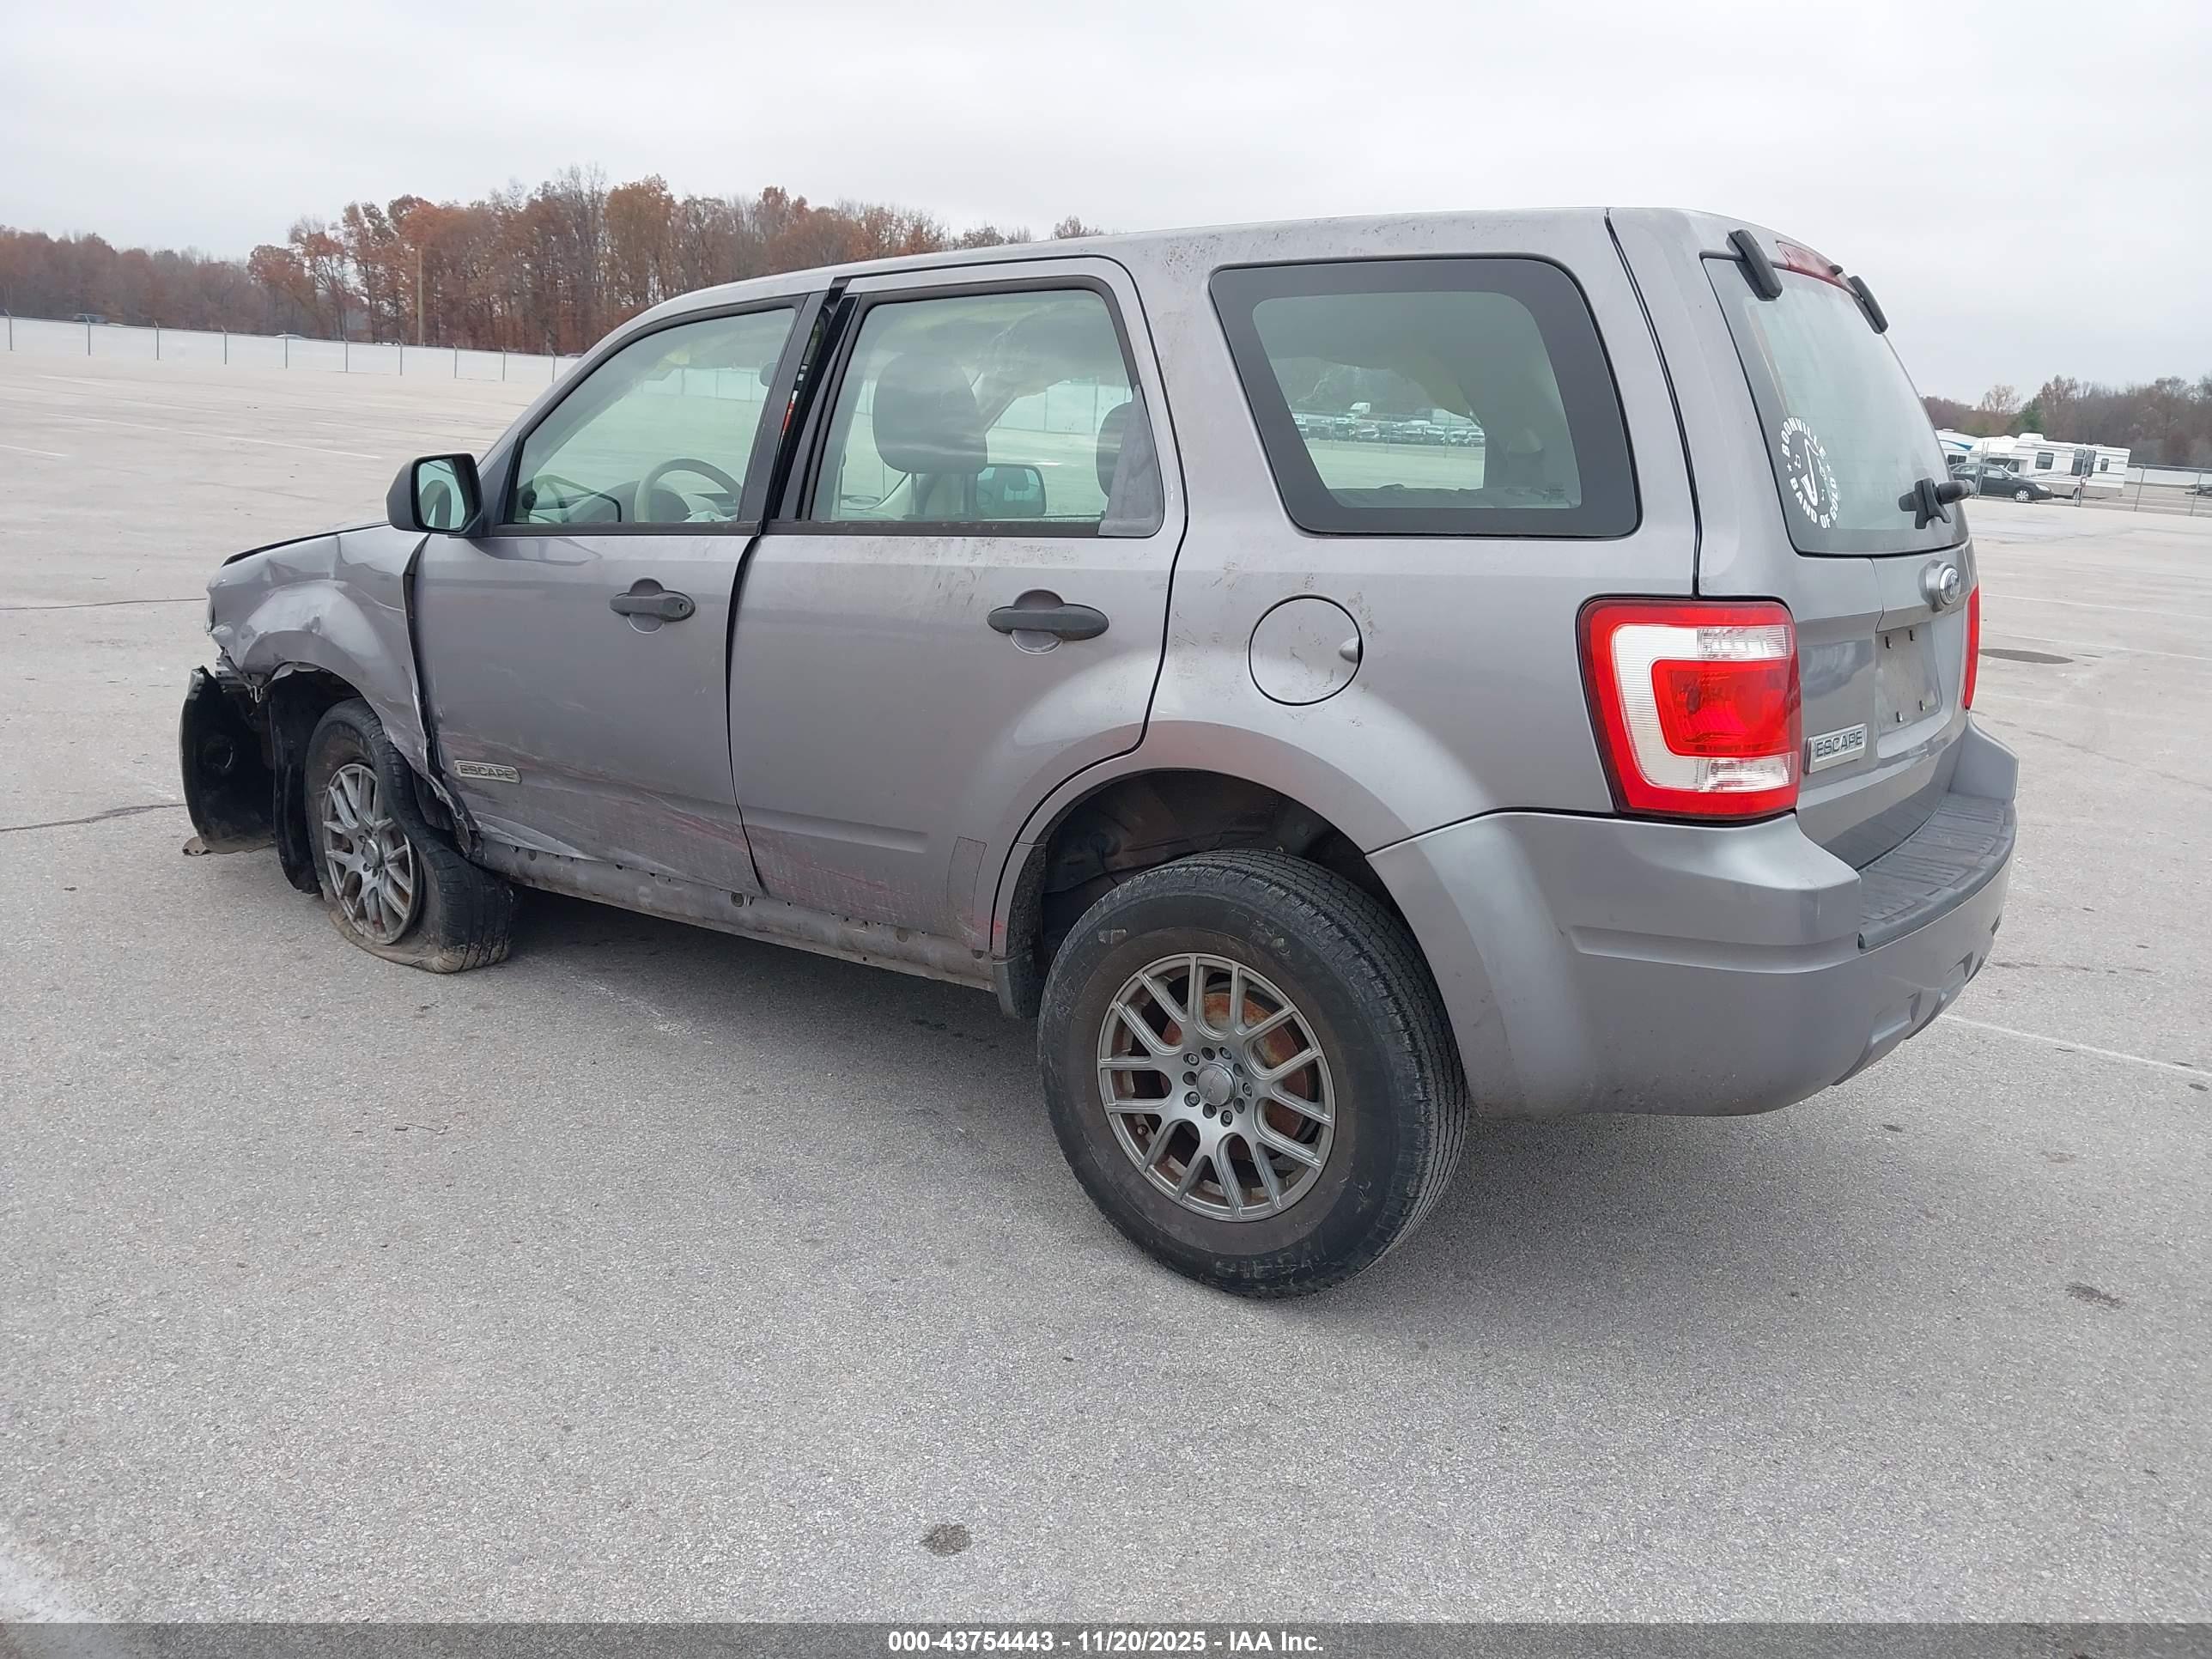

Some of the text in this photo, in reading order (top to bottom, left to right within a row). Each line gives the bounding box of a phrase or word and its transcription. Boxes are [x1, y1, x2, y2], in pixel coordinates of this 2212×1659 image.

[1781, 417, 1826, 459] BOONVILLE
[1790, 477, 1838, 529] BAND OF GOLD
[1815, 730, 1863, 757] ESCAPE
[459, 763, 514, 780] ESCAPE
